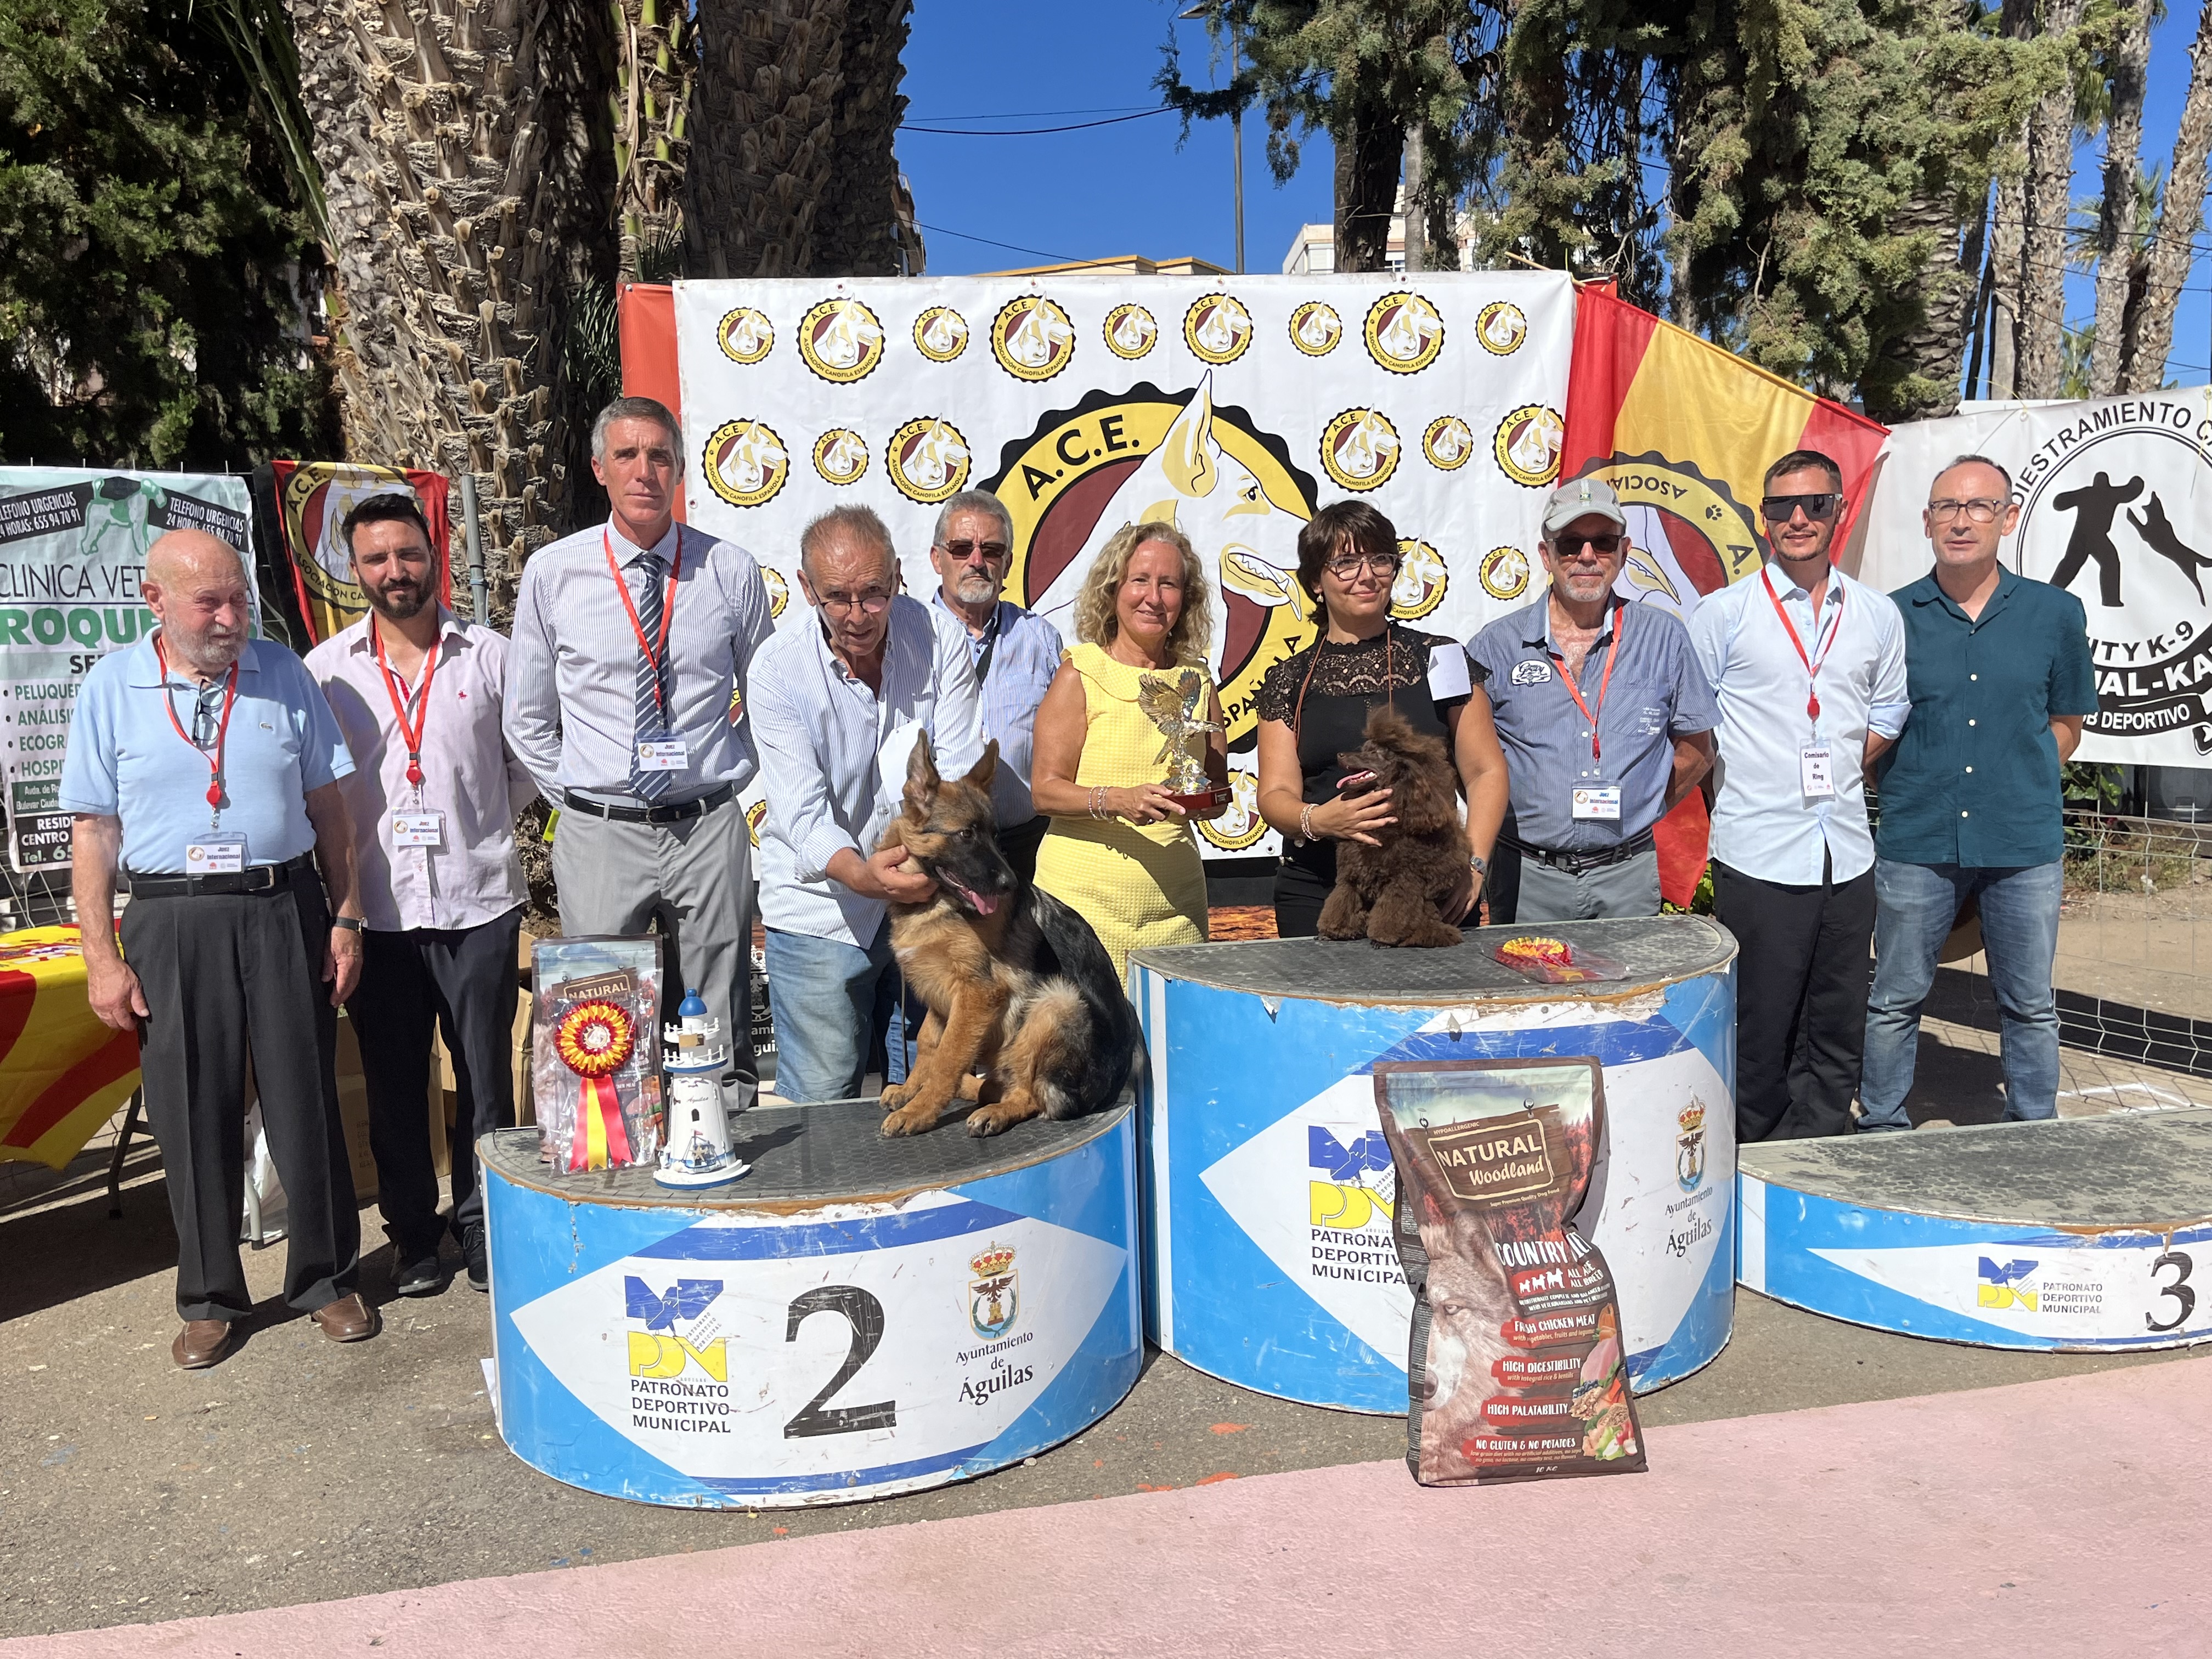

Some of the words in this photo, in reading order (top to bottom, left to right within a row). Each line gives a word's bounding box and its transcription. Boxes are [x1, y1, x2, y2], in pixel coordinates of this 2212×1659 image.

[811, 304, 838, 321] A.C.E.
[1004, 302, 1030, 319] A.C.E.
[1194, 298, 1216, 313] A.C.E.
[1376, 297, 1402, 314] A.C.E.
[1333, 414, 1358, 431] A.C.E.
[1507, 411, 1531, 428] A.C.E.
[715, 426, 742, 443] A.C.E.
[900, 424, 926, 441] A.C.E.
[1022, 414, 1140, 501] A.C.E.
[287, 467, 327, 514] A.C.E.
[0, 501, 31, 521] LEFONO
[31, 492, 76, 514] URGENCIAS
[171, 497, 204, 520] TELEFONO
[206, 509, 244, 532] URGENCIAS
[5, 518, 33, 537] HORAS:
[34, 514, 49, 530] 655
[49, 514, 60, 527] 94
[60, 511, 71, 524] 70
[71, 508, 81, 522] 91
[166, 513, 174, 526] 24
[0, 563, 96, 598] CLINICA
[2147, 620, 2193, 658] K-9
[18, 703, 74, 726] ANÁLISI
[2101, 703, 2190, 730] DEPORTIVO
[20, 734, 66, 751] ECOGR
[25, 786, 41, 795] Avda.
[42, 785, 50, 794] de
[16, 800, 39, 811] Bulevar
[21, 831, 69, 846] CENTRO
[22, 850, 47, 863] Tel.
[568, 981, 628, 1000] NATURAL
[1433, 1121, 1480, 1135] HYPOALLERGENIC
[1436, 1135, 1542, 1167] NATURAL
[1469, 1155, 1545, 1186] Woodland
[1665, 1187, 1712, 1218] Ayuntamiento
[1688, 1209, 1696, 1222] de
[1311, 1228, 1395, 1249] PATRONA
[1666, 1217, 1712, 1257] Águilas
[1496, 1240, 1568, 1267] COUNTRY
[1312, 1263, 1417, 1285] MUNICIPAL
[1567, 1268, 1581, 1278] ALL
[1583, 1260, 1596, 1277] AGE
[1571, 1279, 1583, 1288] ALL
[1584, 1269, 1604, 1285] BREED
[2043, 1282, 2103, 1291] PATRONATO
[2043, 1294, 2102, 1302] DEPORTIVO
[2145, 1251, 2196, 1333] 3
[2042, 1305, 2101, 1313] MUNICIPAL
[1538, 1318, 1574, 1331] CHICKEN
[1576, 1314, 1595, 1327] MEAT
[955, 1330, 1034, 1366] Ayuntamiento
[783, 1285, 896, 1440] 2
[991, 1356, 1005, 1370] de
[1503, 1361, 1525, 1373] HIGH
[1527, 1358, 1581, 1373] DIGESTIBILITY
[958, 1364, 1034, 1406] Águilas
[1521, 1374, 1543, 1383] integral
[631, 1379, 729, 1397] PATRONATO
[632, 1397, 730, 1415] DEPORTIVO
[1487, 1404, 1509, 1415] HIGH
[1512, 1403, 1568, 1416] PALATABILITY
[633, 1414, 731, 1433] MUNICIPAL
[1476, 1439, 1487, 1449] NO
[1489, 1440, 1517, 1451] GLUTEN
[1520, 1441, 1525, 1450] &
[1528, 1440, 1539, 1449] NO
[1542, 1437, 1576, 1449] POTATOES
